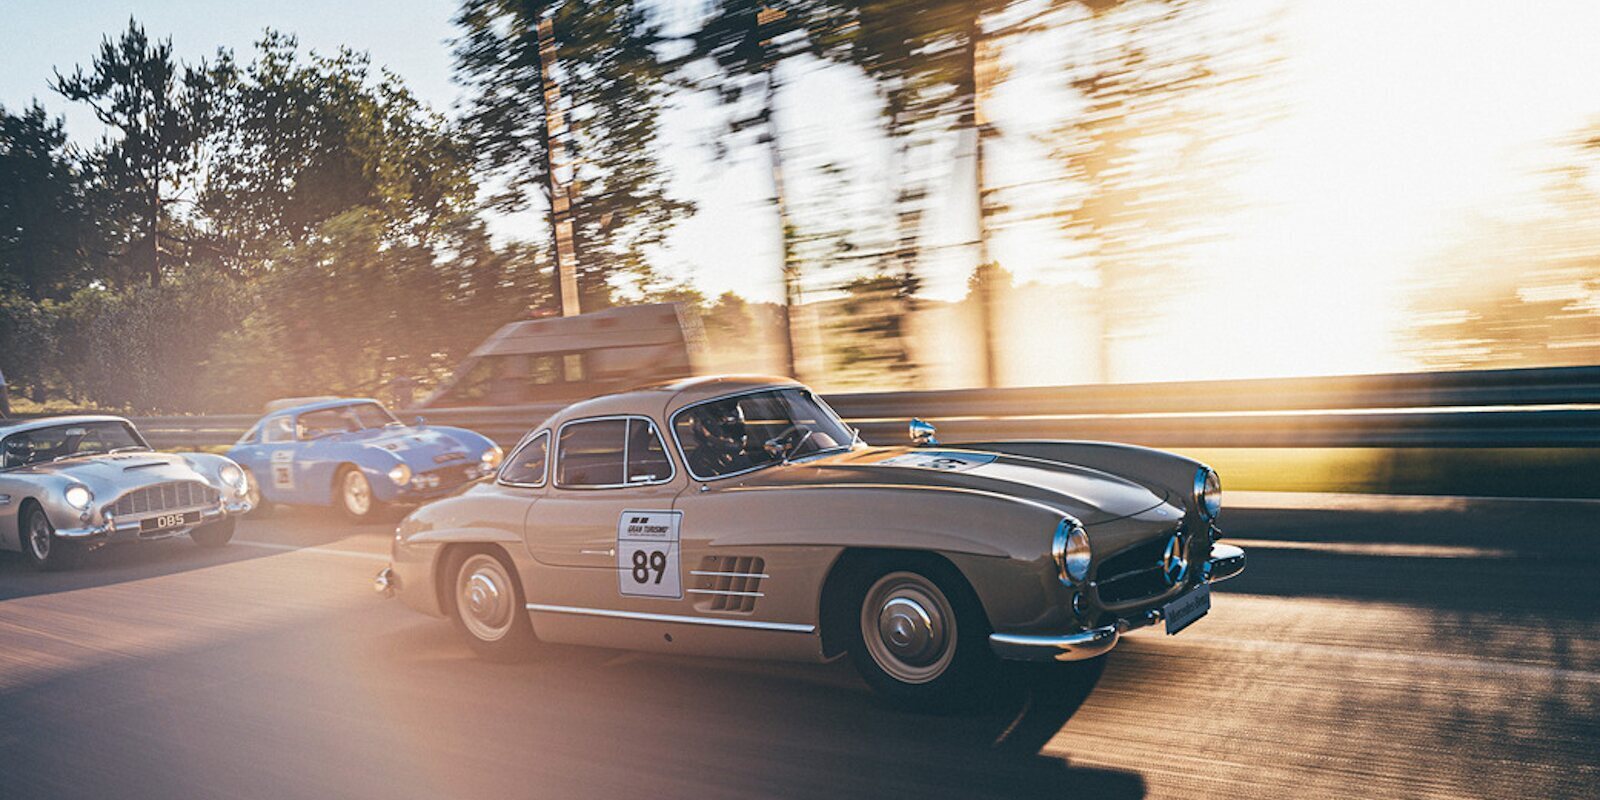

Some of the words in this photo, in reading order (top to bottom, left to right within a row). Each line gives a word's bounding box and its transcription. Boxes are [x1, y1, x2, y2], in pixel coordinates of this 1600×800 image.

[627, 525, 643, 534] GRAN
[644, 525, 669, 534] TURISMO
[632, 550, 666, 585] 89
